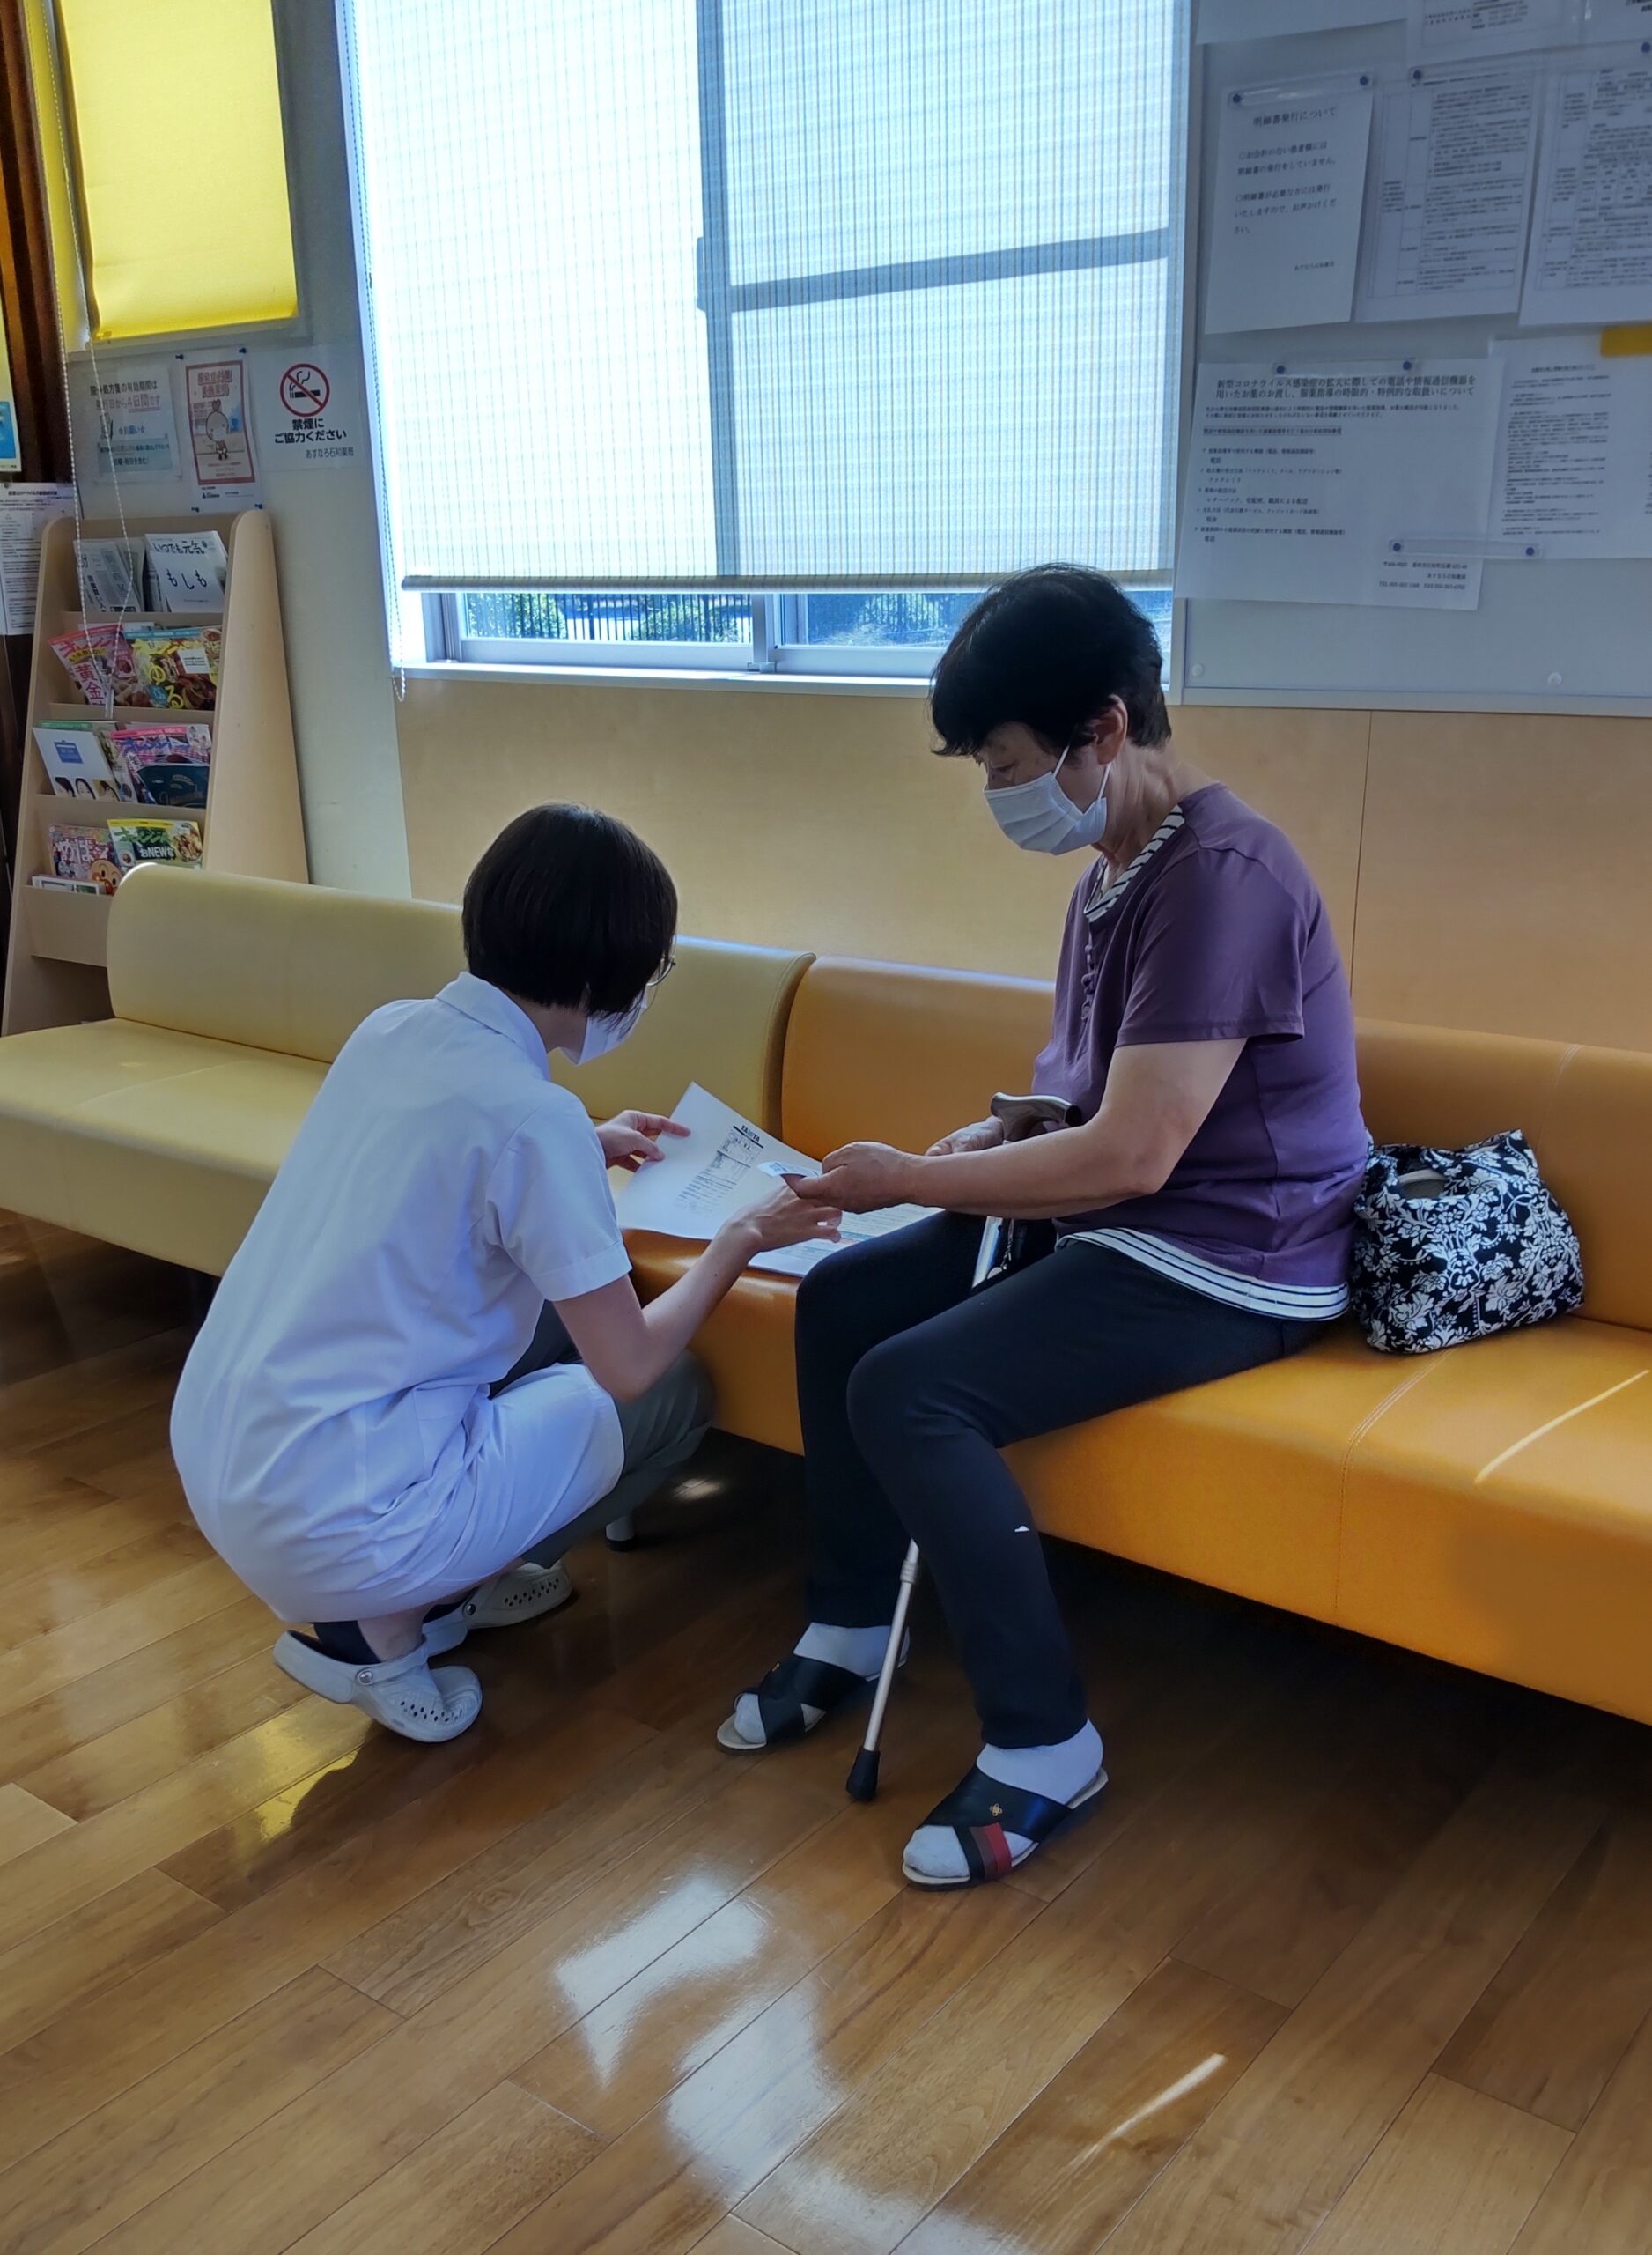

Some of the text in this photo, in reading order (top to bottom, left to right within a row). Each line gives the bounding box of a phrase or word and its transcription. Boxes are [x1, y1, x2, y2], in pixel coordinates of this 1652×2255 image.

[291, 418, 324, 431] 禁煙に
[275, 429, 347, 444] ご協力ください
[152, 540, 205, 554] いつでも元気
[166, 569, 208, 598] もしも
[75, 663, 106, 705] 黄金
